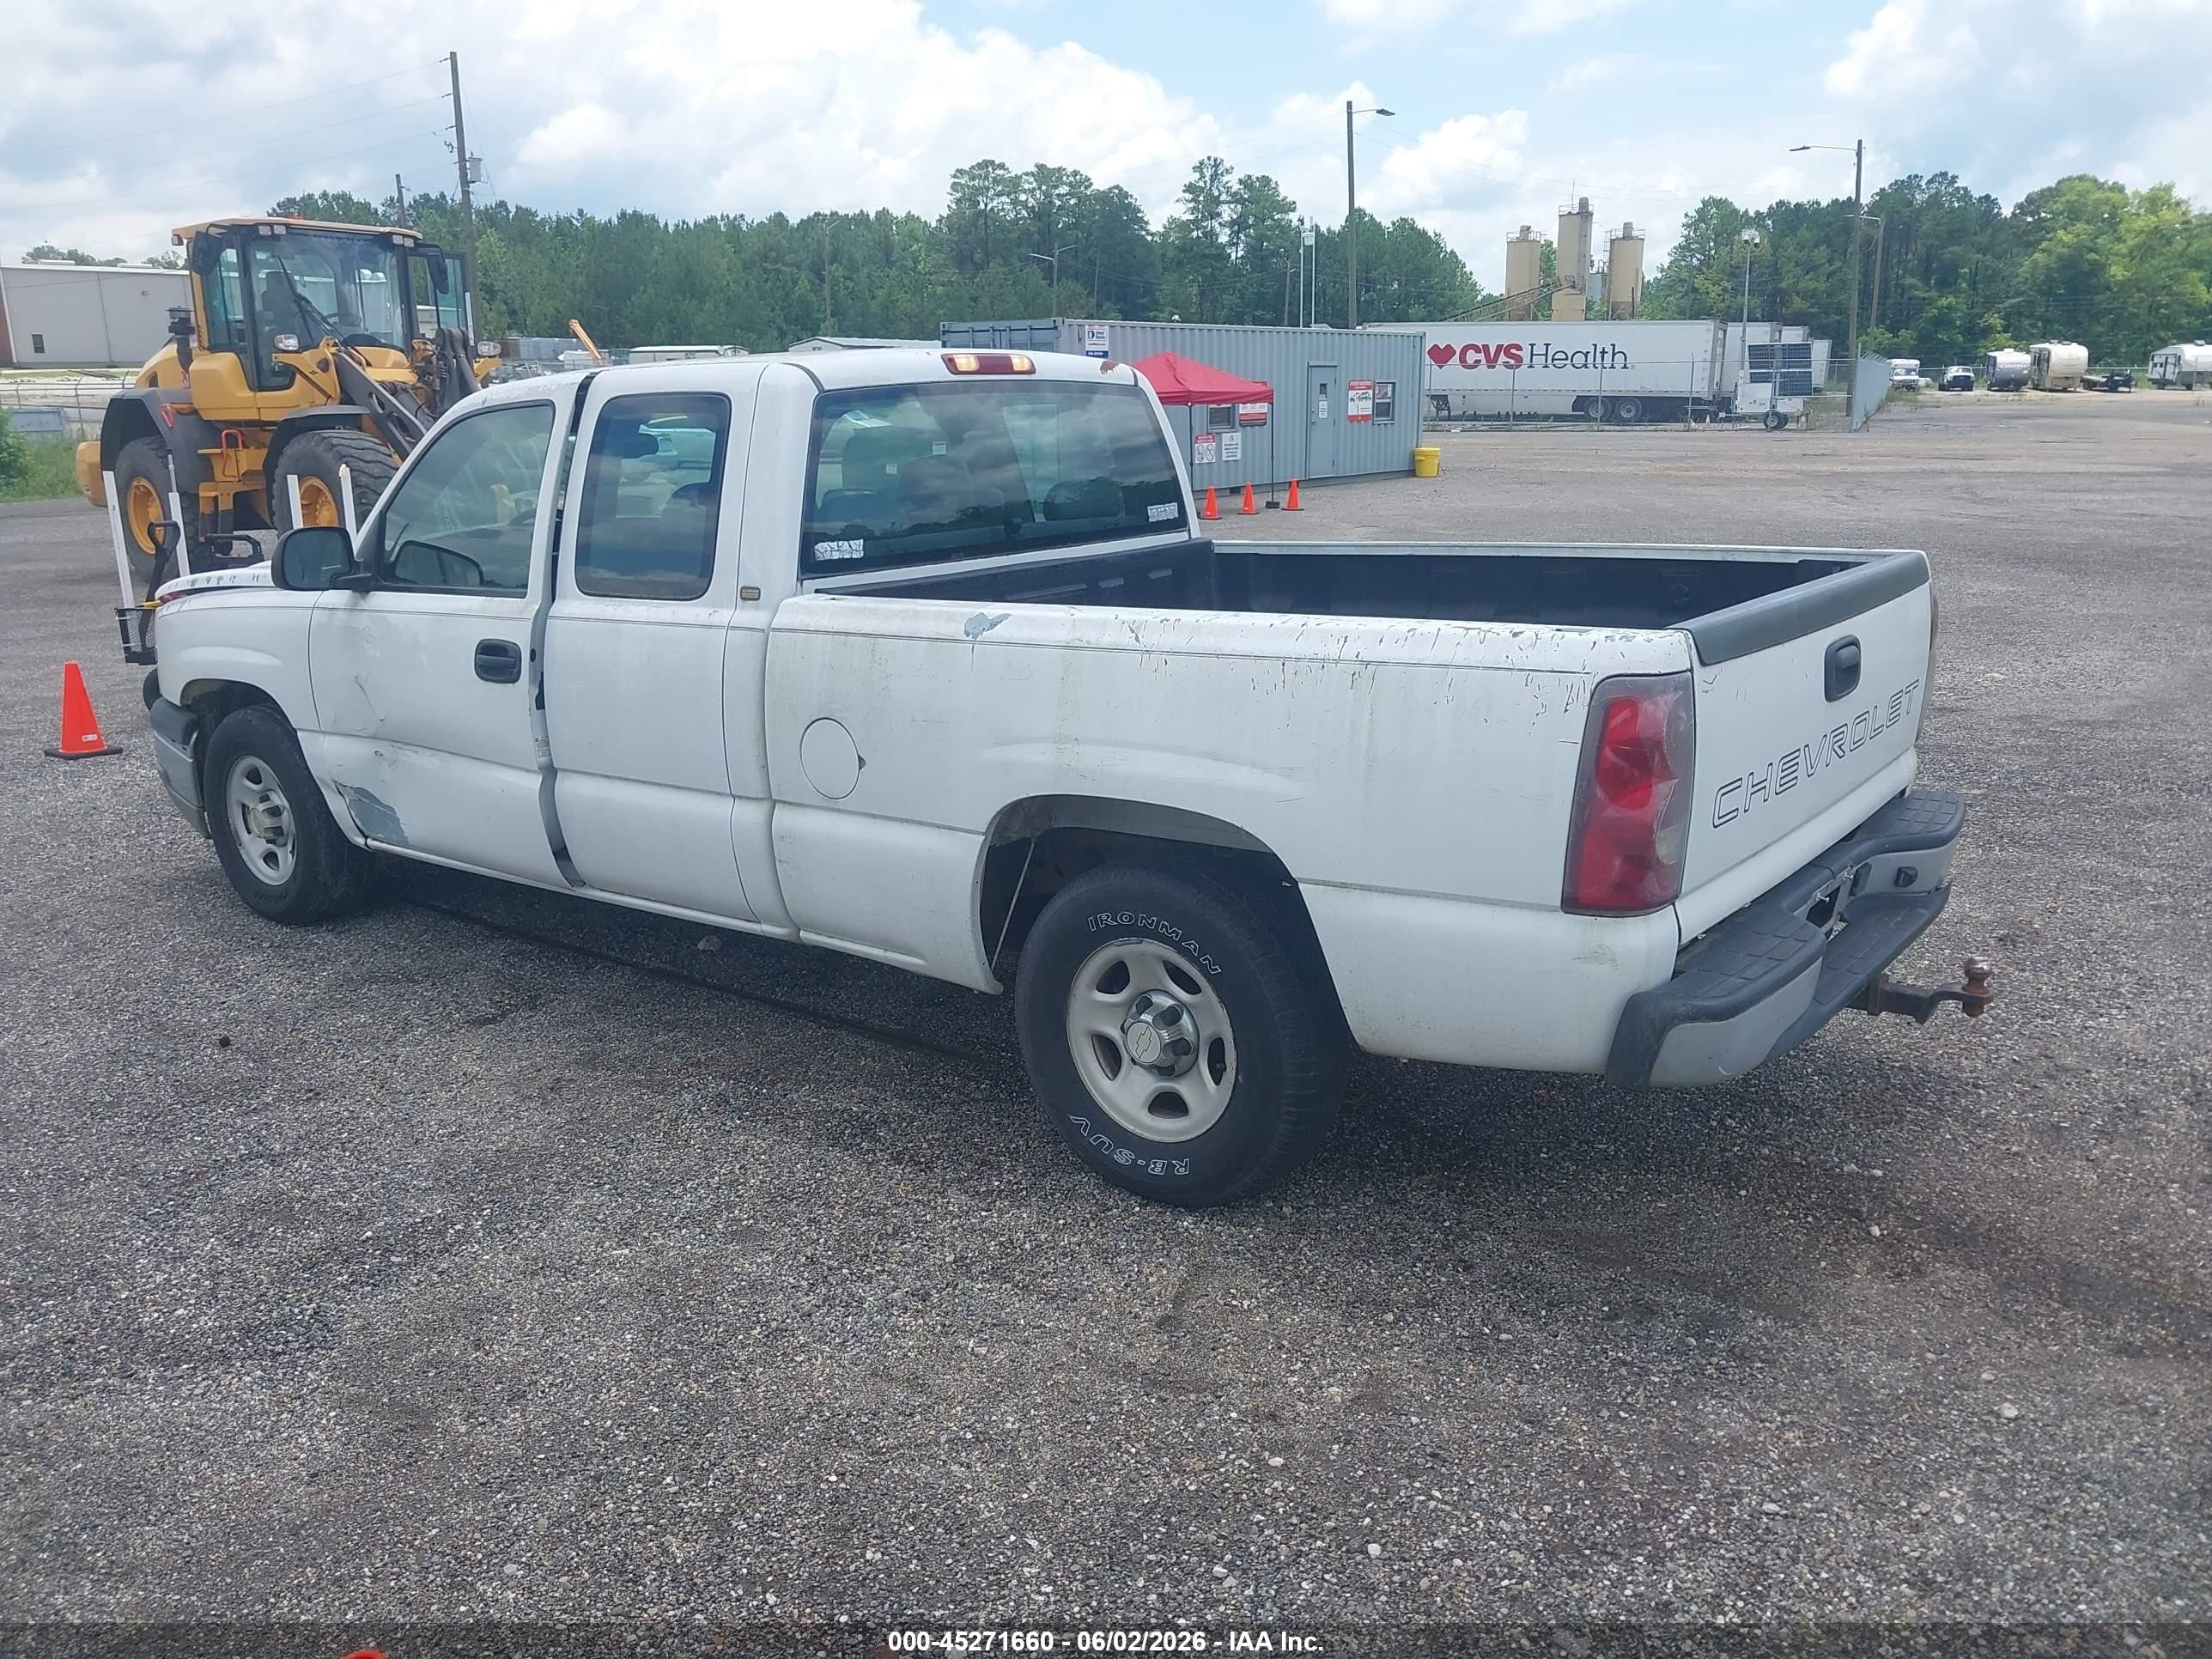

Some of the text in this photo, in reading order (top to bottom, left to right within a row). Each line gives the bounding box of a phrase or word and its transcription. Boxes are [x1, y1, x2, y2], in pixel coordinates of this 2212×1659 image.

[1458, 343, 1630, 370] CVS Health
[1712, 679, 1920, 829] CHEVROLET
[1087, 910, 1223, 975] IRONMAN
[1068, 1114, 1191, 1176] RB-SUV
